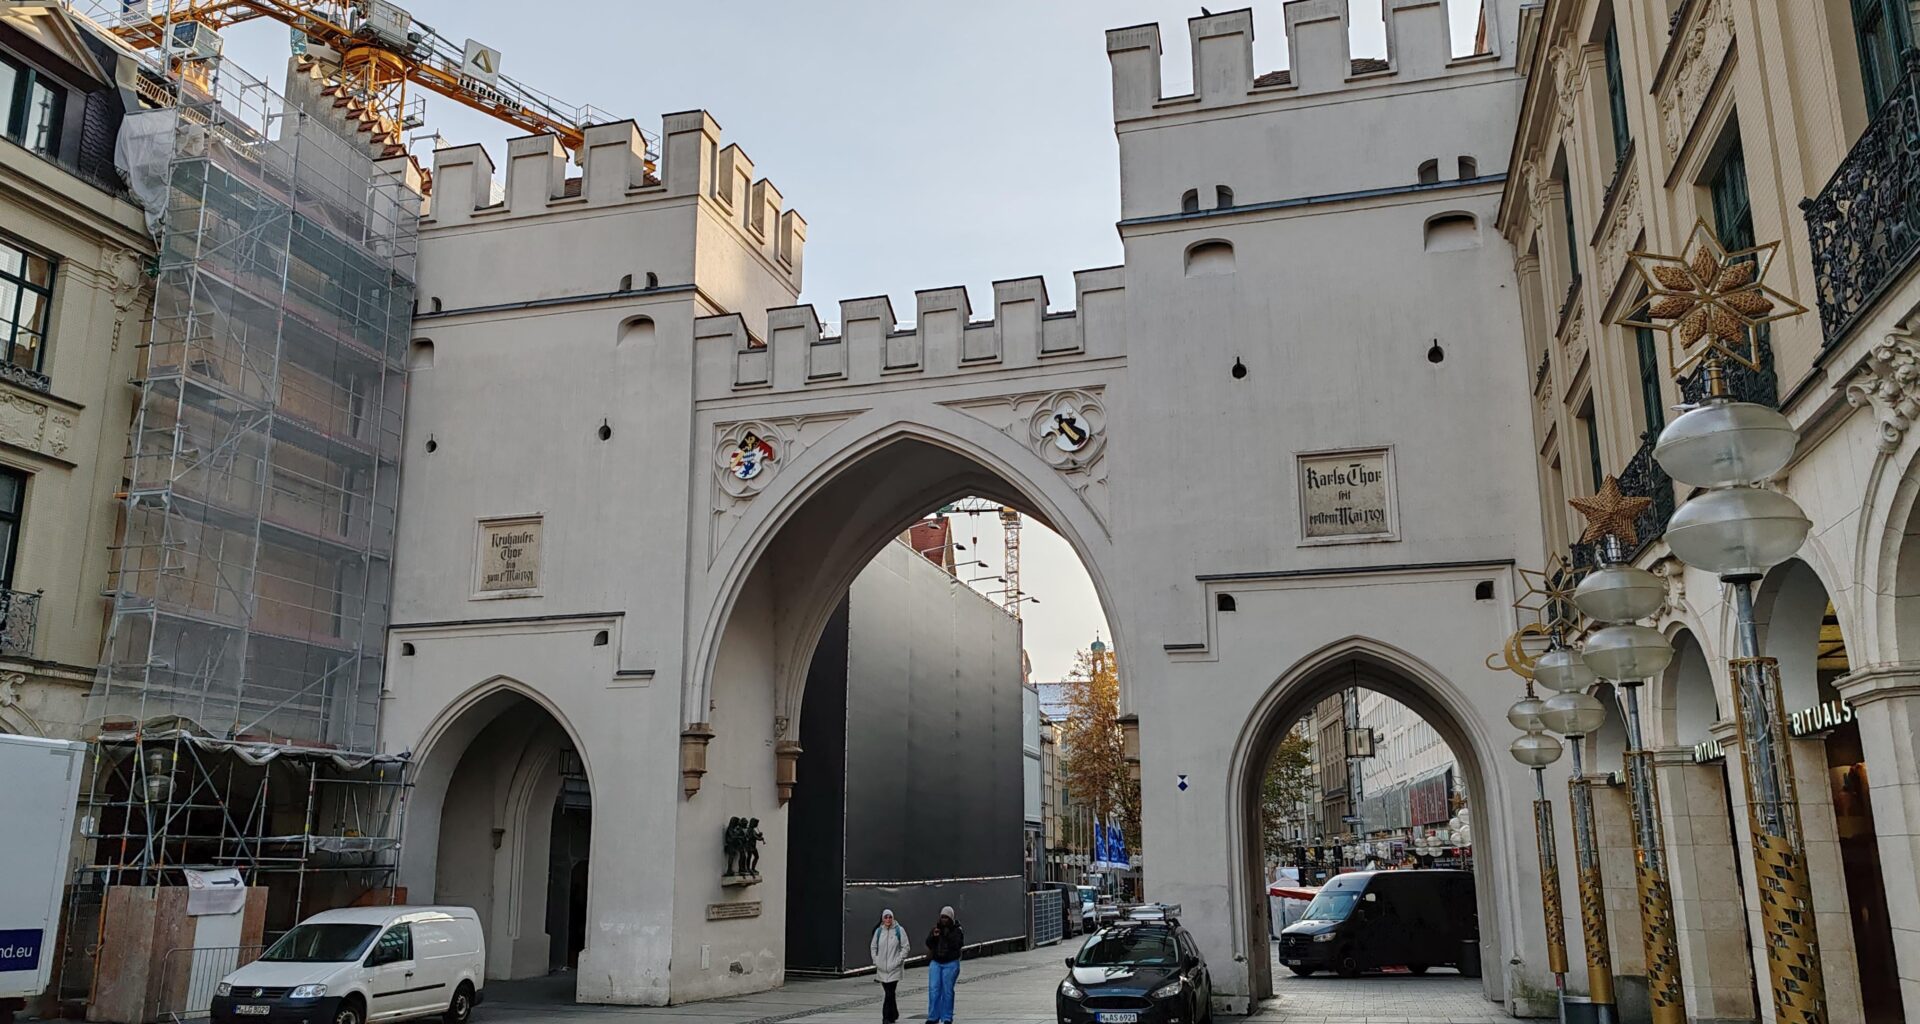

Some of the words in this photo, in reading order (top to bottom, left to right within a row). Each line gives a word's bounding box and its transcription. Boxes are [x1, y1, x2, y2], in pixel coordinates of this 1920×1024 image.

[459, 79, 521, 110] LIEBHERR
[1306, 466, 1345, 490] Karls
[1347, 463, 1382, 487] Thor
[1335, 506, 1363, 526] Mai
[500, 546, 523, 560] Thor
